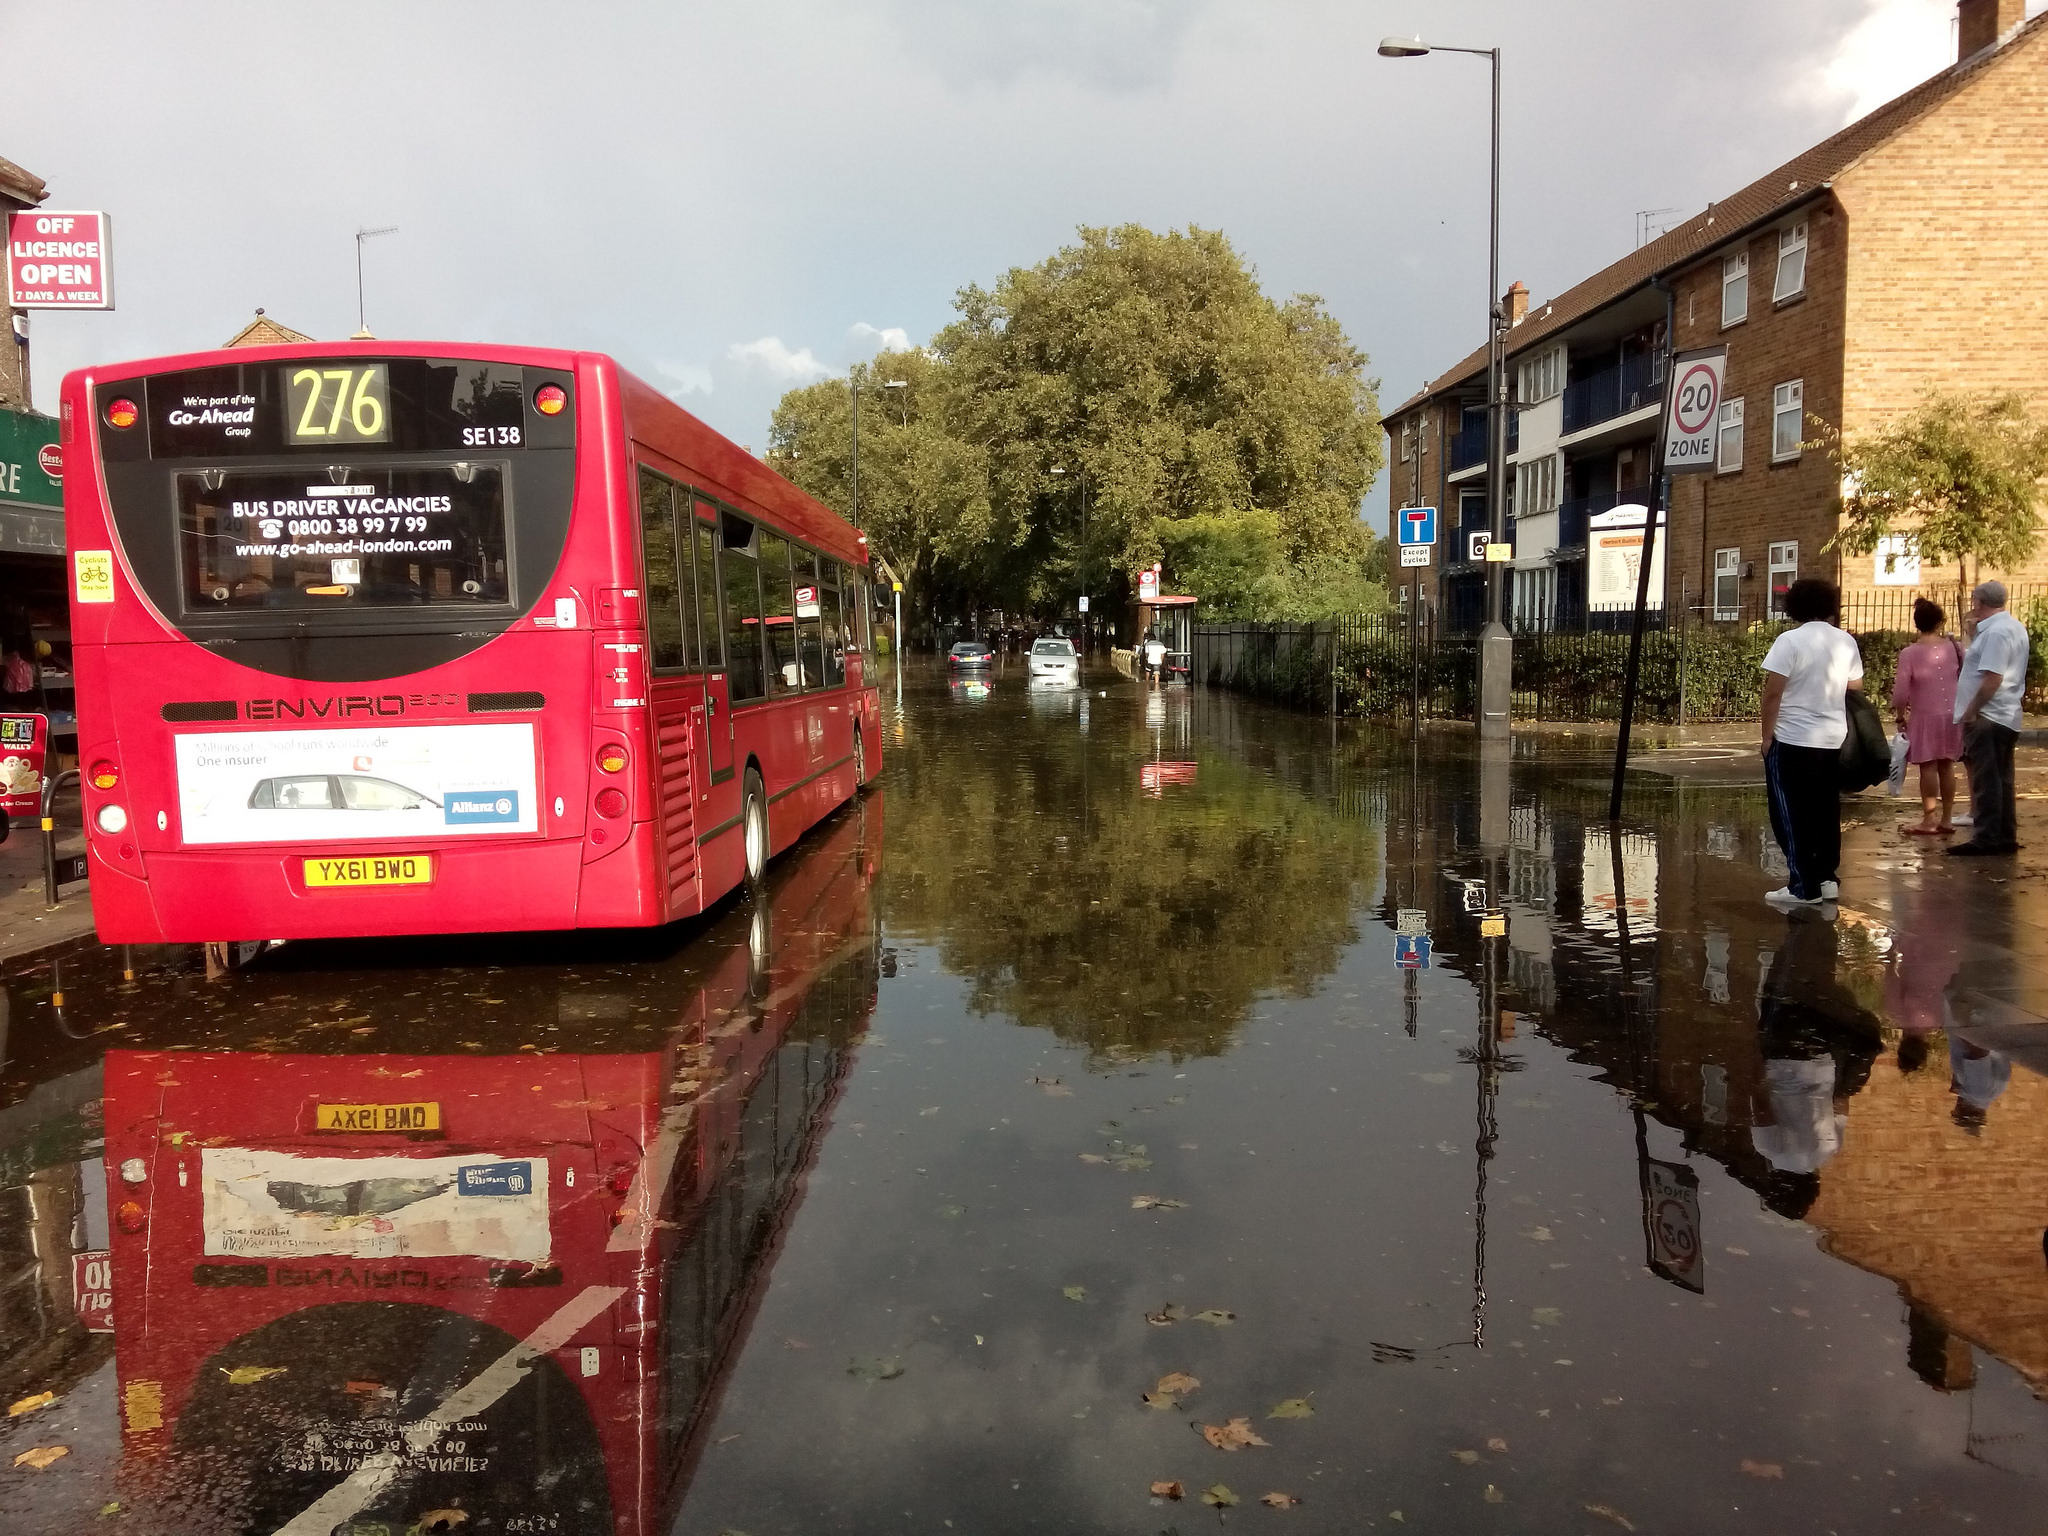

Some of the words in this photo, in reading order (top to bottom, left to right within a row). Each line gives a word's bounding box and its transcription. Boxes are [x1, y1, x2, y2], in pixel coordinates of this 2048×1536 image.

[36, 217, 75, 234] OFF
[14, 241, 99, 258] LICENCE
[21, 264, 92, 285] OPEN
[15, 291, 23, 300] 7
[25, 291, 55, 300] DAYS
[56, 291, 65, 300] A
[67, 291, 100, 300] WEEK
[183, 396, 207, 406] We're
[210, 396, 228, 407] part
[230, 394, 241, 406] of
[241, 394, 256, 405] the
[293, 368, 383, 436] 276
[1681, 383, 1712, 413] 20
[169, 407, 255, 426] Go-Ahead
[225, 427, 252, 438] Group
[463, 426, 521, 445] SE138
[1670, 438, 1710, 457] ZONE
[232, 501, 269, 517] BUS
[273, 499, 339, 516] DRIVER
[344, 496, 452, 514] VACANCIES
[288, 519, 332, 535] 0800
[336, 518, 358, 534] 38
[363, 517, 385, 533] 99
[389, 517, 400, 532] 7
[405, 516, 427, 532] 99
[236, 538, 452, 558] www.go-ahead-london.com
[79, 556, 108, 565] Cyclists
[246, 695, 405, 720] ENVIRO
[409, 693, 459, 706] 200
[195, 741, 240, 753] Millions
[242, 741, 254, 752] of
[197, 756, 221, 767] One
[225, 754, 268, 766] insurer
[452, 800, 495, 814] Allianz
[319, 861, 367, 880] YX61
[374, 859, 416, 879] BWO
